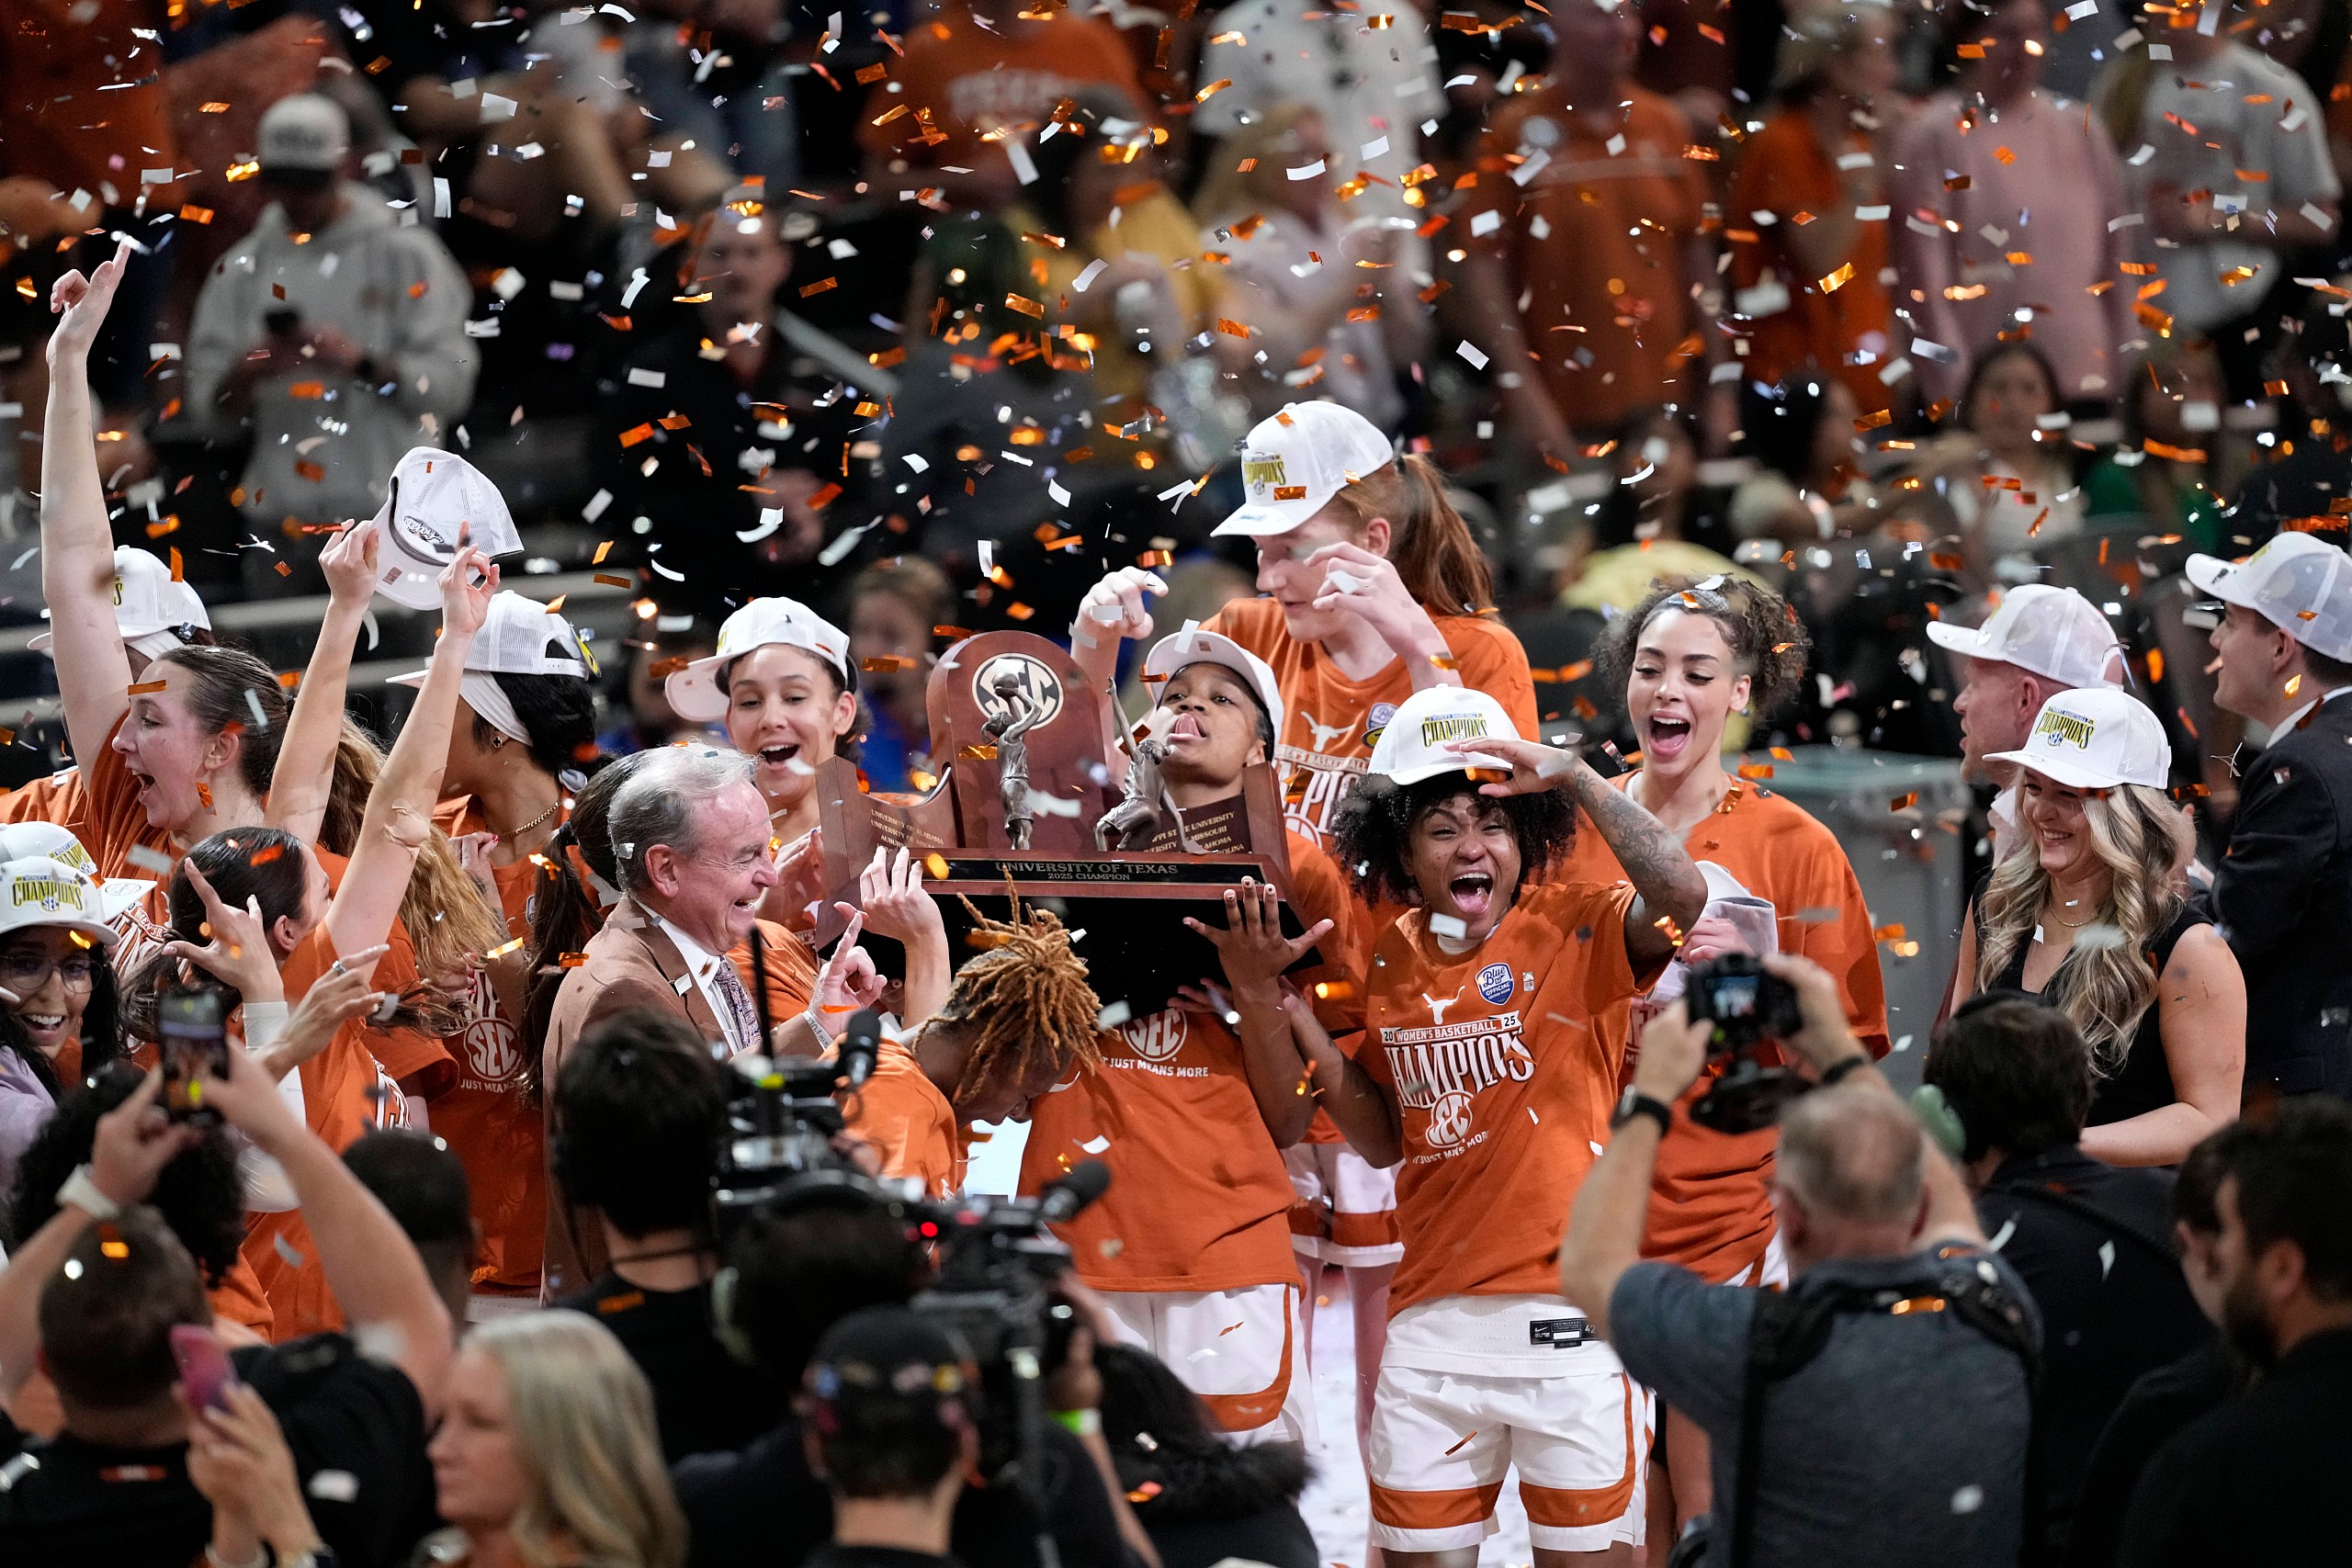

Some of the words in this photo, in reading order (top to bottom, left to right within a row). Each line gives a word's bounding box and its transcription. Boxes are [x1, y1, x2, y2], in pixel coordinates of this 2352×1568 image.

[1421, 718, 1488, 747] CHAMPIONS
[2035, 712, 2095, 749] CHAMPIONS
[870, 819, 905, 840] UNIVERSITY
[871, 809, 905, 829] UNIVERSITY
[916, 829, 944, 845] ALABAMA
[1191, 811, 1235, 830] UNIVERSITY
[1191, 825, 1227, 841] MISSOURI
[1203, 836, 1231, 850] AHOMA
[995, 862, 1094, 873] UNIVERSITY
[1099, 863, 1121, 874] OF
[1124, 864, 1179, 874] TEXAS
[1075, 873, 1130, 881] CHAMPION
[12, 880, 83, 911] CHAMPIONS
[41, 897, 60, 911] SEC
[1483, 966, 1506, 987] Blue
[1485, 982, 1510, 997] OFFICIAL
[1125, 1008, 1183, 1058] SEC
[1384, 1031, 1394, 1042] 20
[1396, 1029, 1433, 1043] WOMEN'S
[1435, 1021, 1497, 1039] BASKETBALL
[1503, 1016, 1516, 1027] 25
[466, 1021, 518, 1078] SEC
[1109, 1057, 1136, 1069] JUST
[1136, 1059, 1175, 1077] MEANS
[1176, 1066, 1209, 1077] MORE
[1385, 1027, 1536, 1117] HAMPIONS
[460, 1078, 482, 1089] JUST
[1419, 1153, 1442, 1165] JUST
[1466, 1130, 1489, 1148] MOR
[1584, 1324, 1597, 1334] 42
